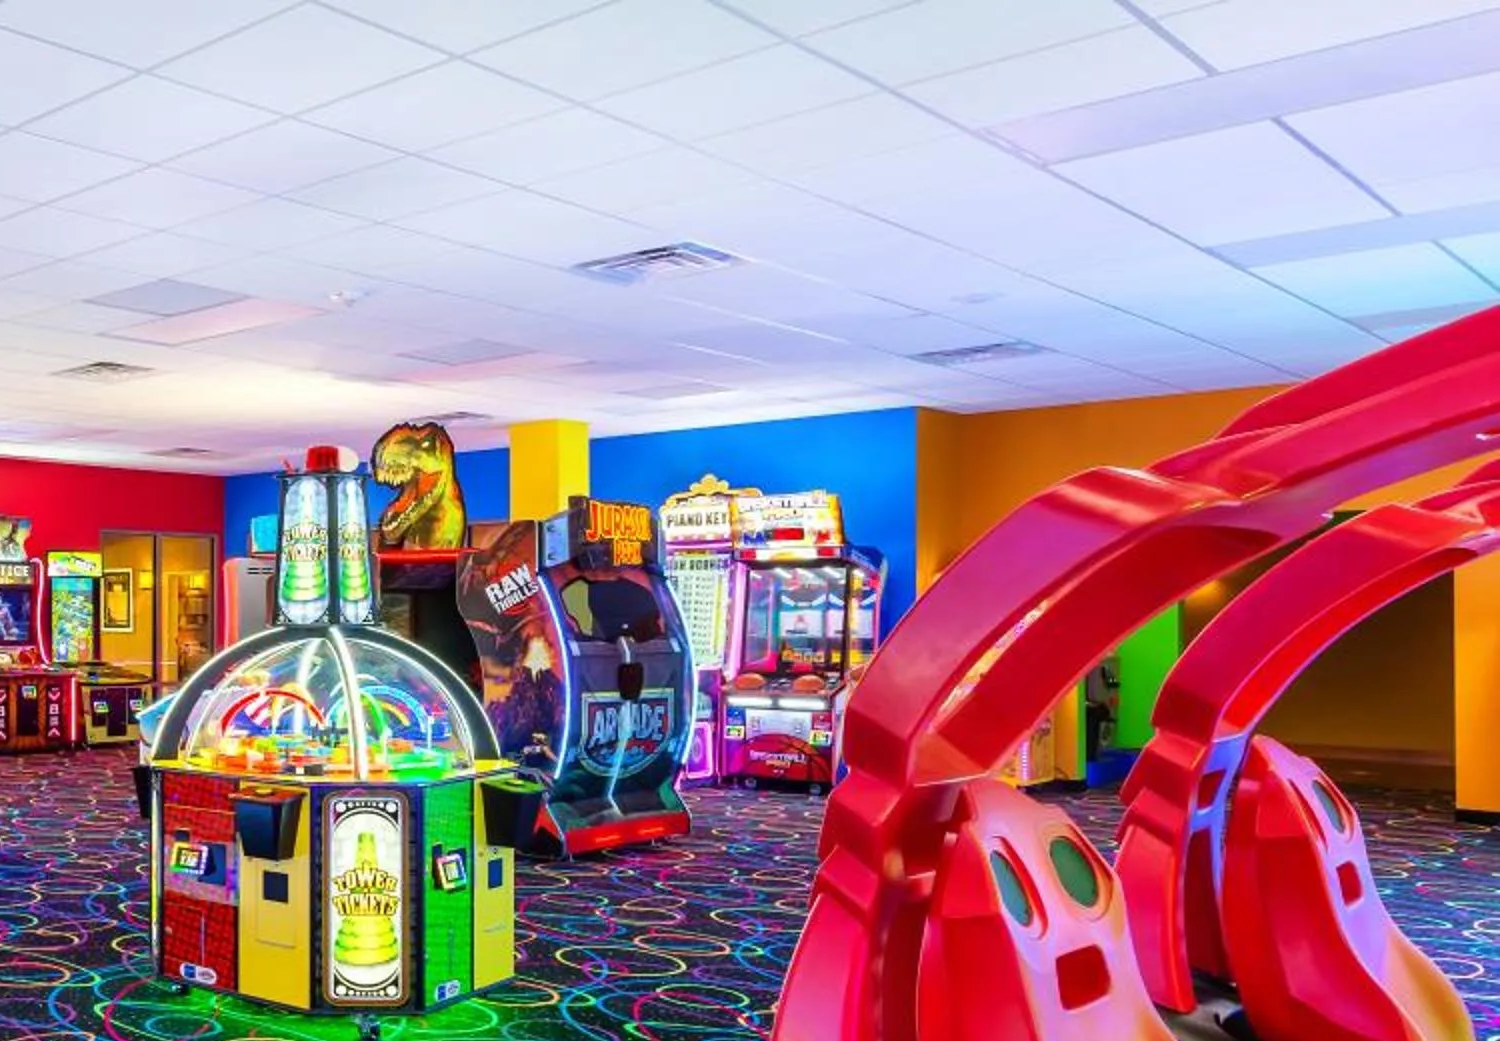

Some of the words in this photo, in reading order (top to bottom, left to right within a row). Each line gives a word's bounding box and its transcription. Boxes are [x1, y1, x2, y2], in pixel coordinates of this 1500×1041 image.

[667, 512, 703, 528] PIANO
[485, 563, 532, 604] RAW
[589, 701, 665, 748] ARCADE
[332, 867, 398, 892] TOWER
[331, 893, 399, 916] TICKETS
